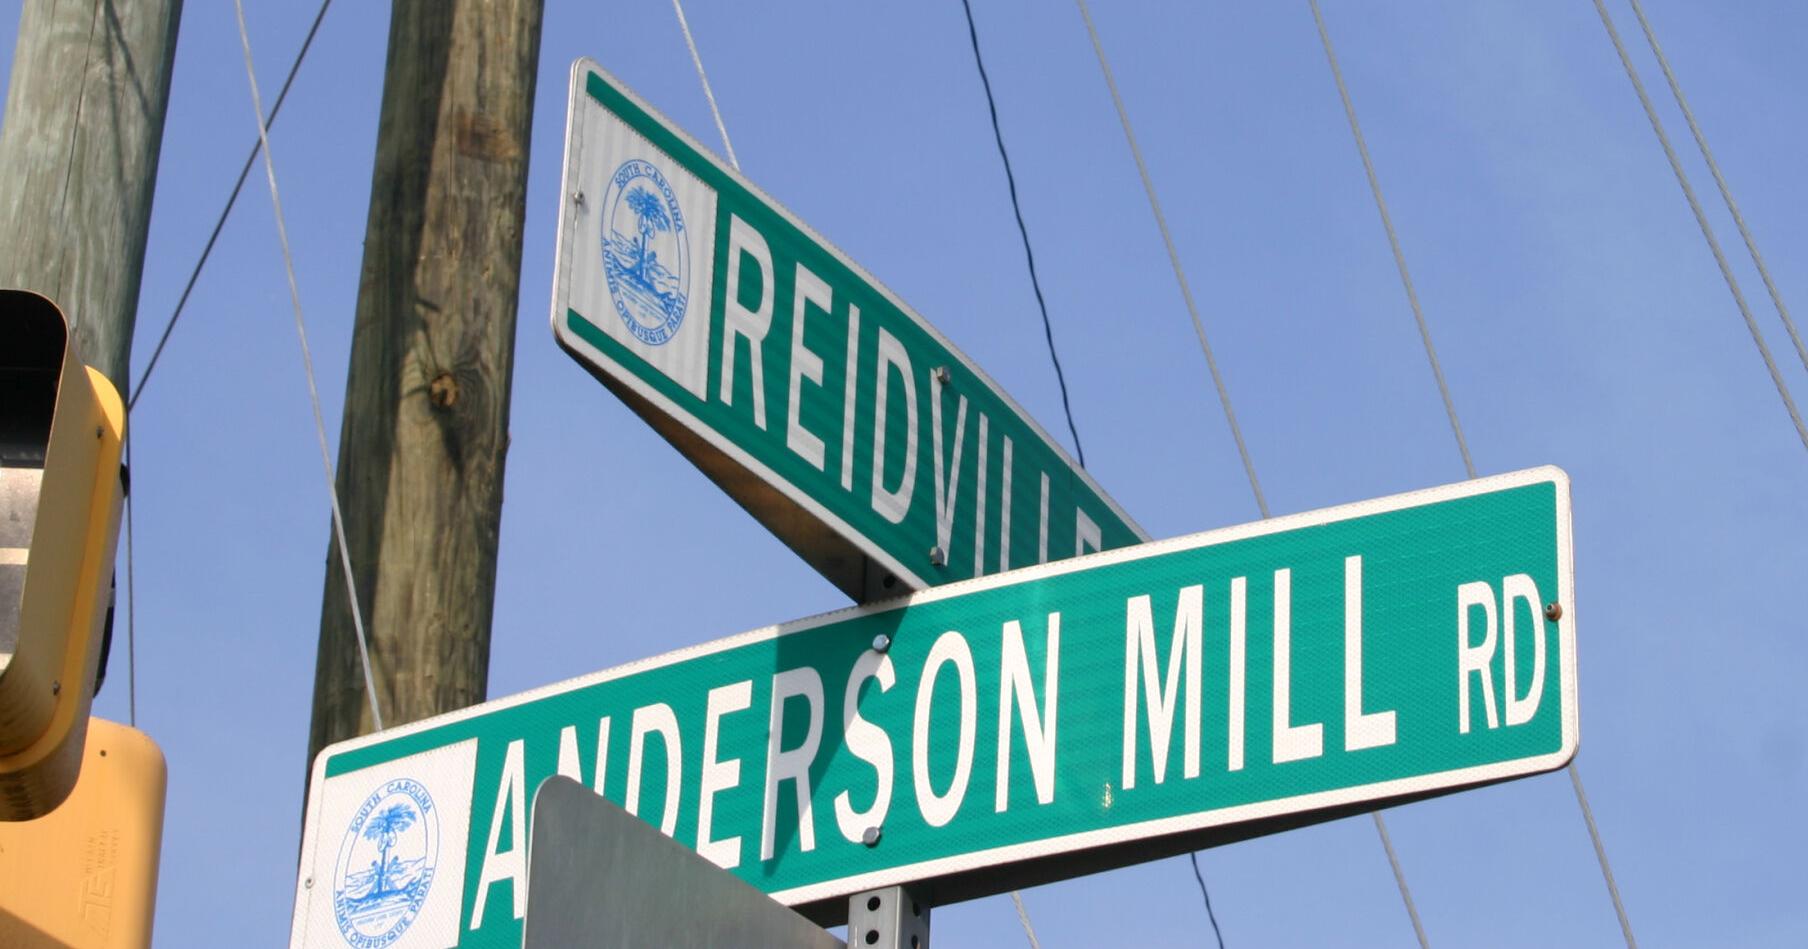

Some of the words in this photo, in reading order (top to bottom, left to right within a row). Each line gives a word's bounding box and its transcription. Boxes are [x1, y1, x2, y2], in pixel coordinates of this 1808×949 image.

[615, 162, 641, 190] SOUTH
[645, 166, 685, 233] CAROLINA
[1122, 554, 1397, 790] MILL
[1457, 573, 1546, 735] RD
[351, 793, 382, 833] SOUTH
[386, 781, 433, 815] CAROLINA
